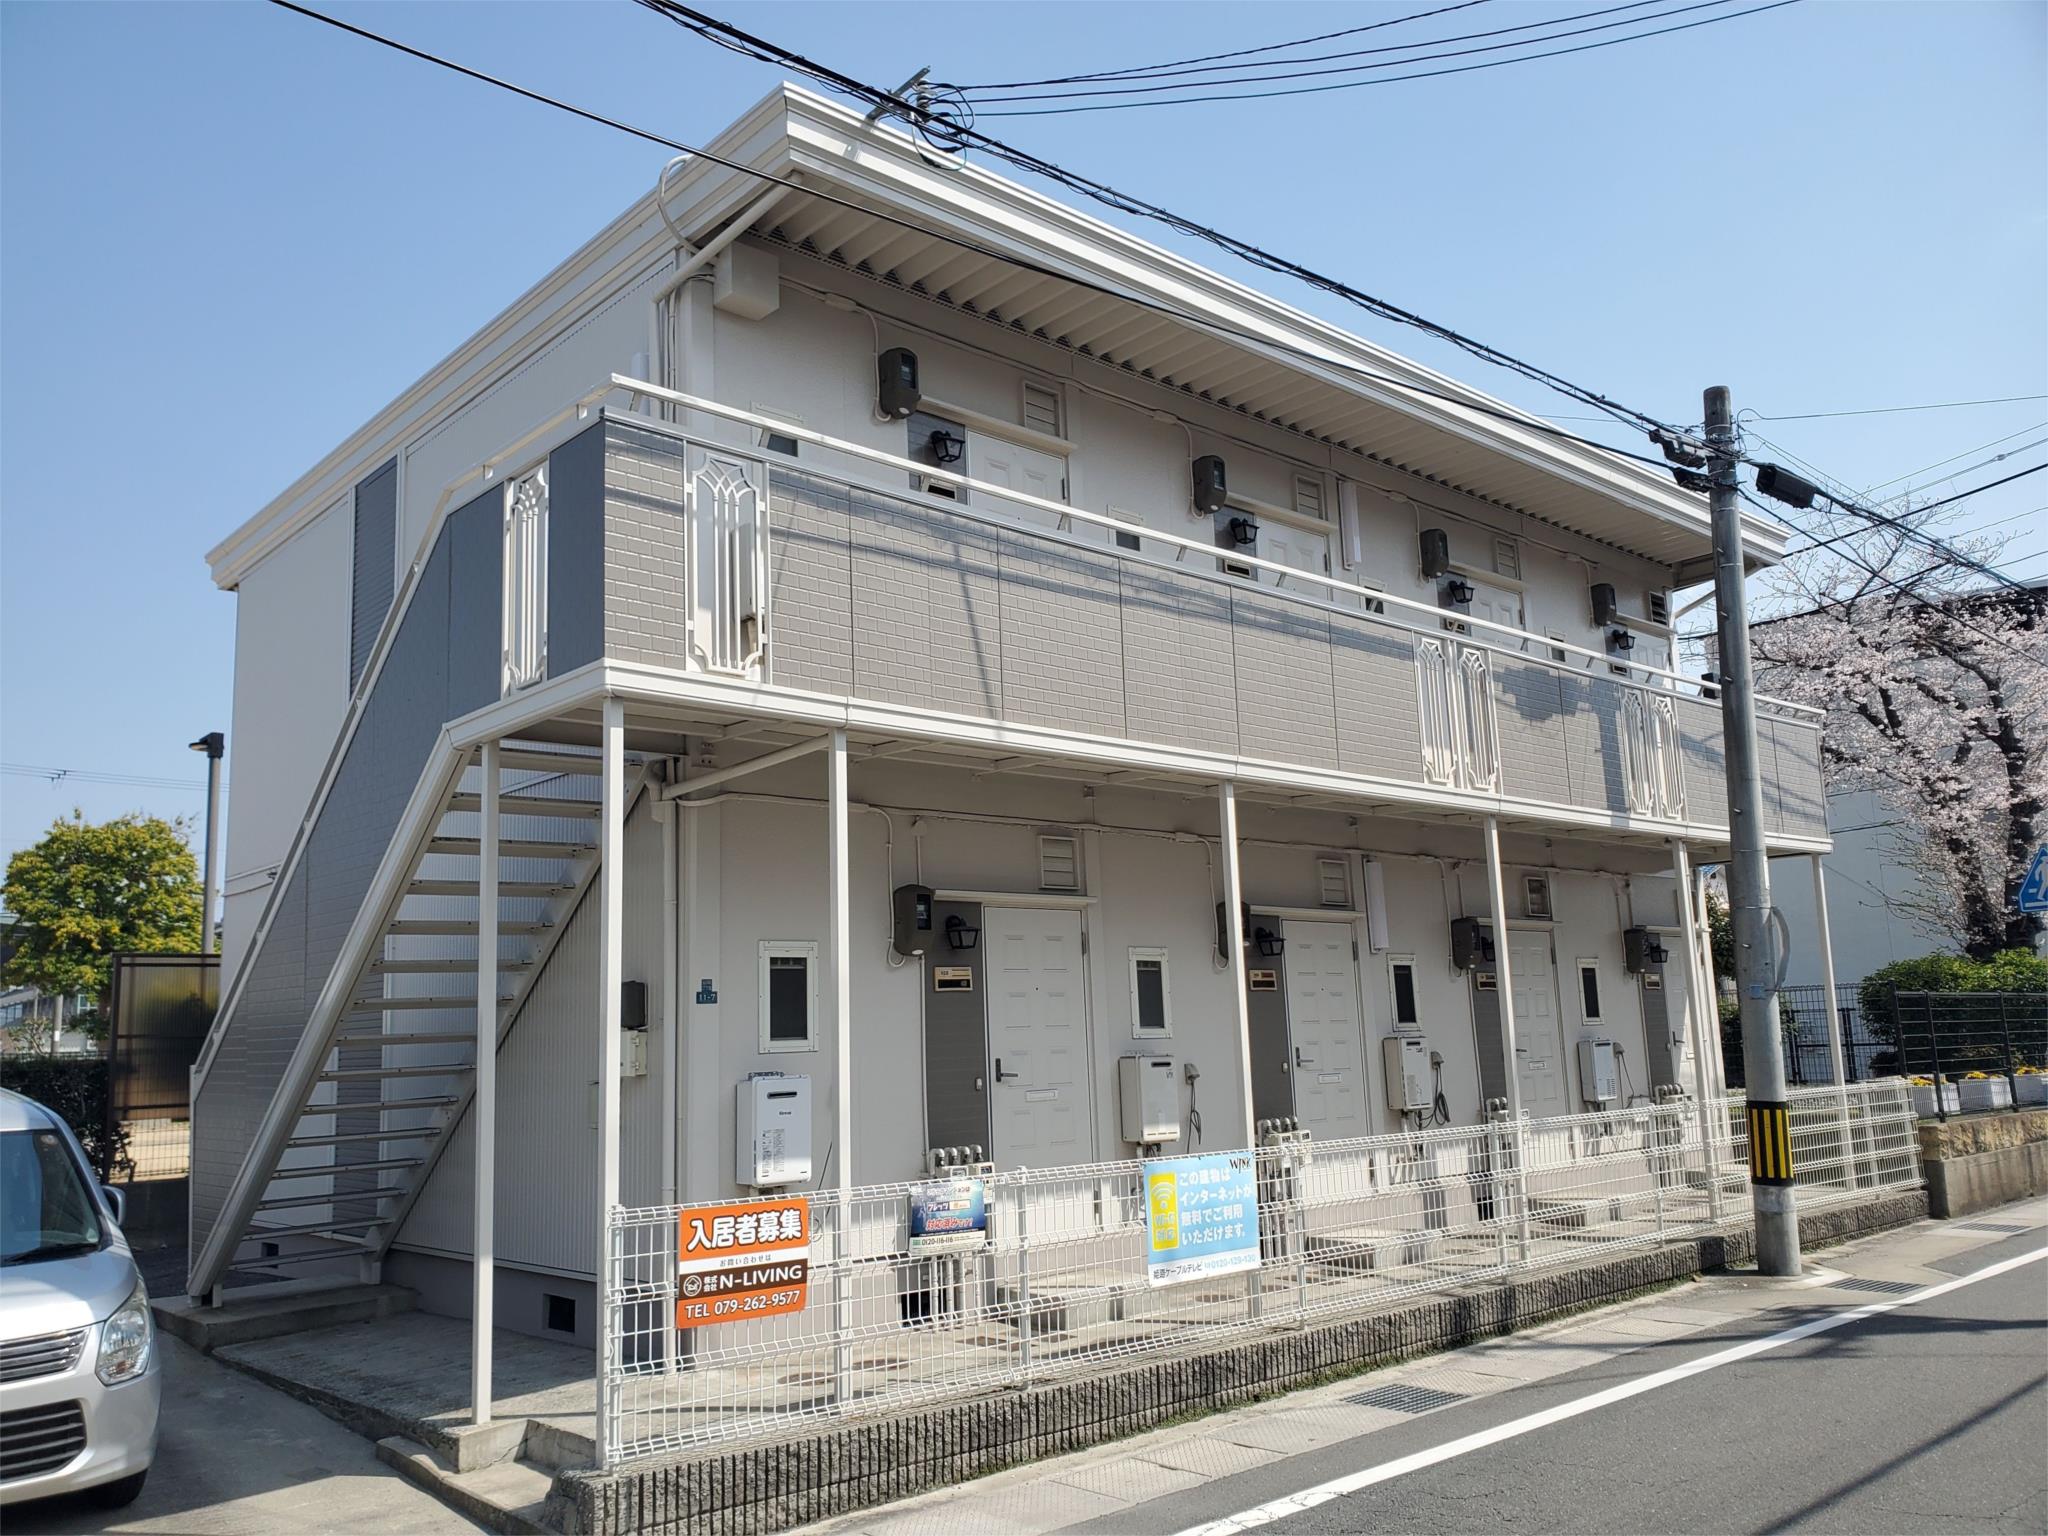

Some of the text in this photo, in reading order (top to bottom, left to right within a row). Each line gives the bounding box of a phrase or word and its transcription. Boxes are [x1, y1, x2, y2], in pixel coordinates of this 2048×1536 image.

[1180, 1183, 1253, 1206] インターネットが
[1181, 1203, 1243, 1226] 無料でご利用
[687, 1209, 801, 1251] 入居者募集
[720, 1265, 802, 1289] N-LIVING
[685, 1290, 800, 1319] TEL 079-262-9577
